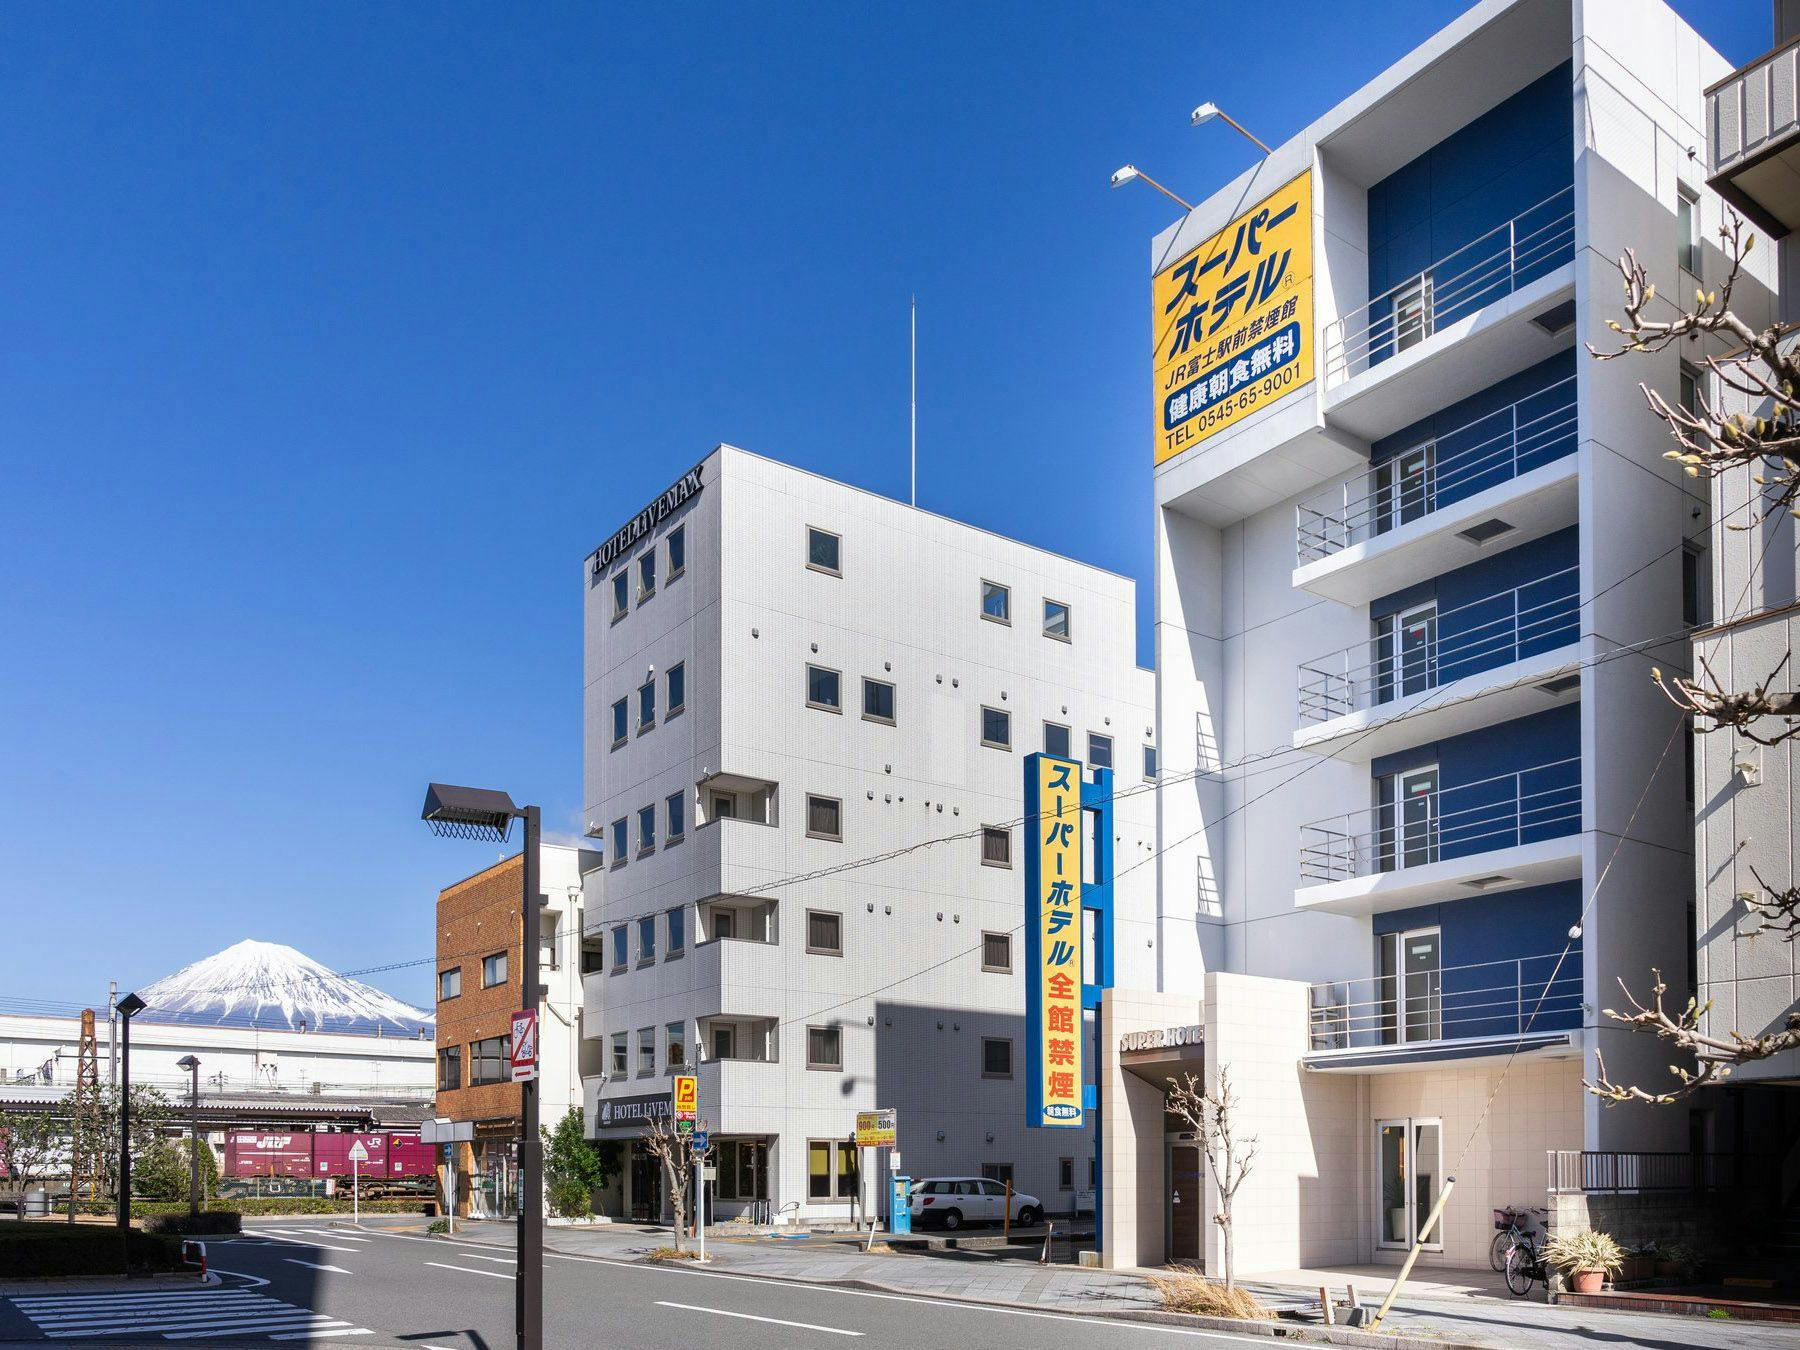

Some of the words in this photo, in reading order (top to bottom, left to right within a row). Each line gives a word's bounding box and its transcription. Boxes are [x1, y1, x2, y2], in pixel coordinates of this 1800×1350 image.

[1165, 202, 1298, 316] スーパー
[1168, 248, 1292, 362] ホテル
[1165, 295, 1299, 390] JR富士駅前禁煙館
[1168, 329, 1295, 424] 健康朝食無料
[1165, 424, 1195, 450] TEL
[1198, 362, 1301, 432] 0545-65-9001
[592, 522, 637, 574] HOTEL
[1045, 763, 1075, 967] スーパーホテル
[1047, 971, 1075, 1099] 全館禁煙
[1120, 1029, 1165, 1052] SUPER
[1165, 1024, 1205, 1047] HOTE
[367, 1137, 382, 1146] JR
[614, 1103, 643, 1120] HOTEL
[643, 1100, 673, 1117] LiVEM
